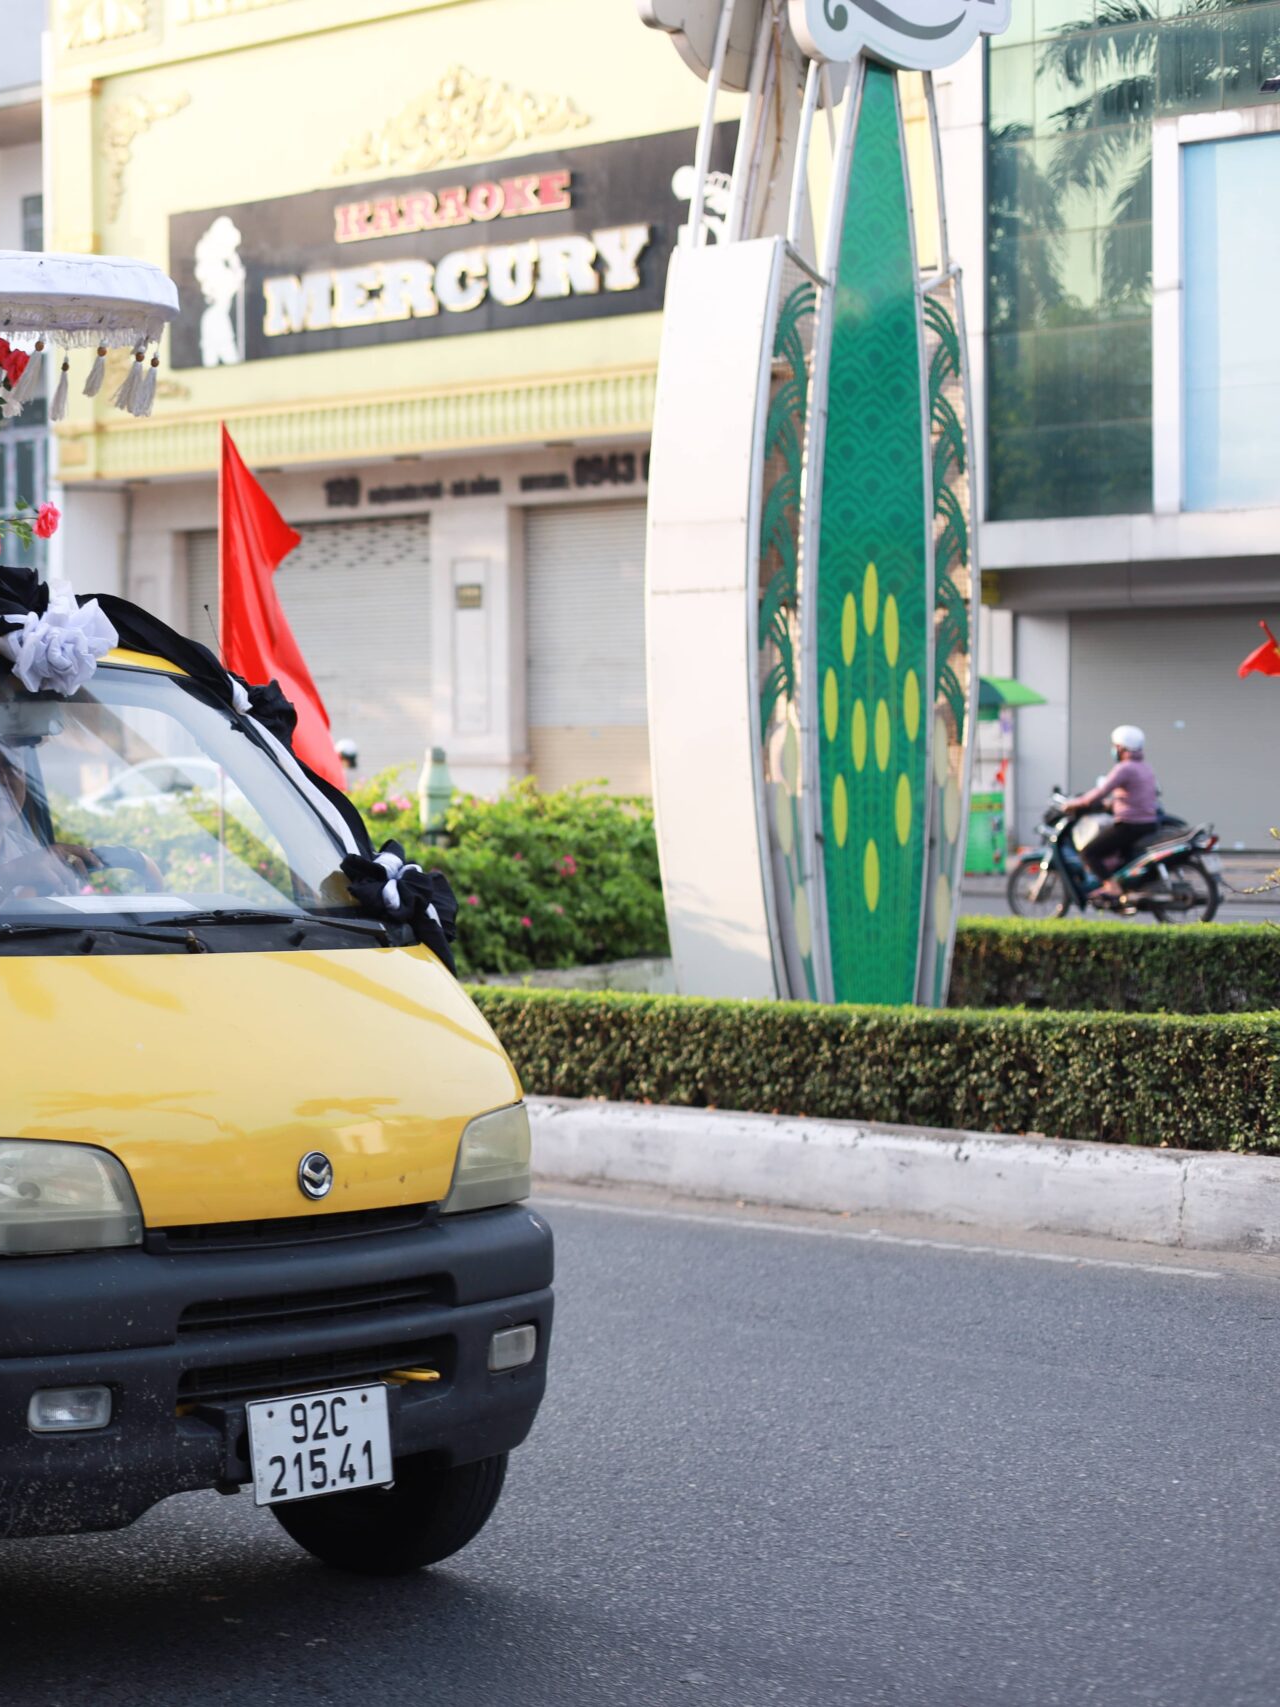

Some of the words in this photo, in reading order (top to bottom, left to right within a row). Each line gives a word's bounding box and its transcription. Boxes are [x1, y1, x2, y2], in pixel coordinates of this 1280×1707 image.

[334, 169, 571, 243] KARAOKE
[263, 223, 651, 337] MERCURY
[290, 1397, 348, 1443] 92C
[268, 1440, 373, 1497] 215.41
